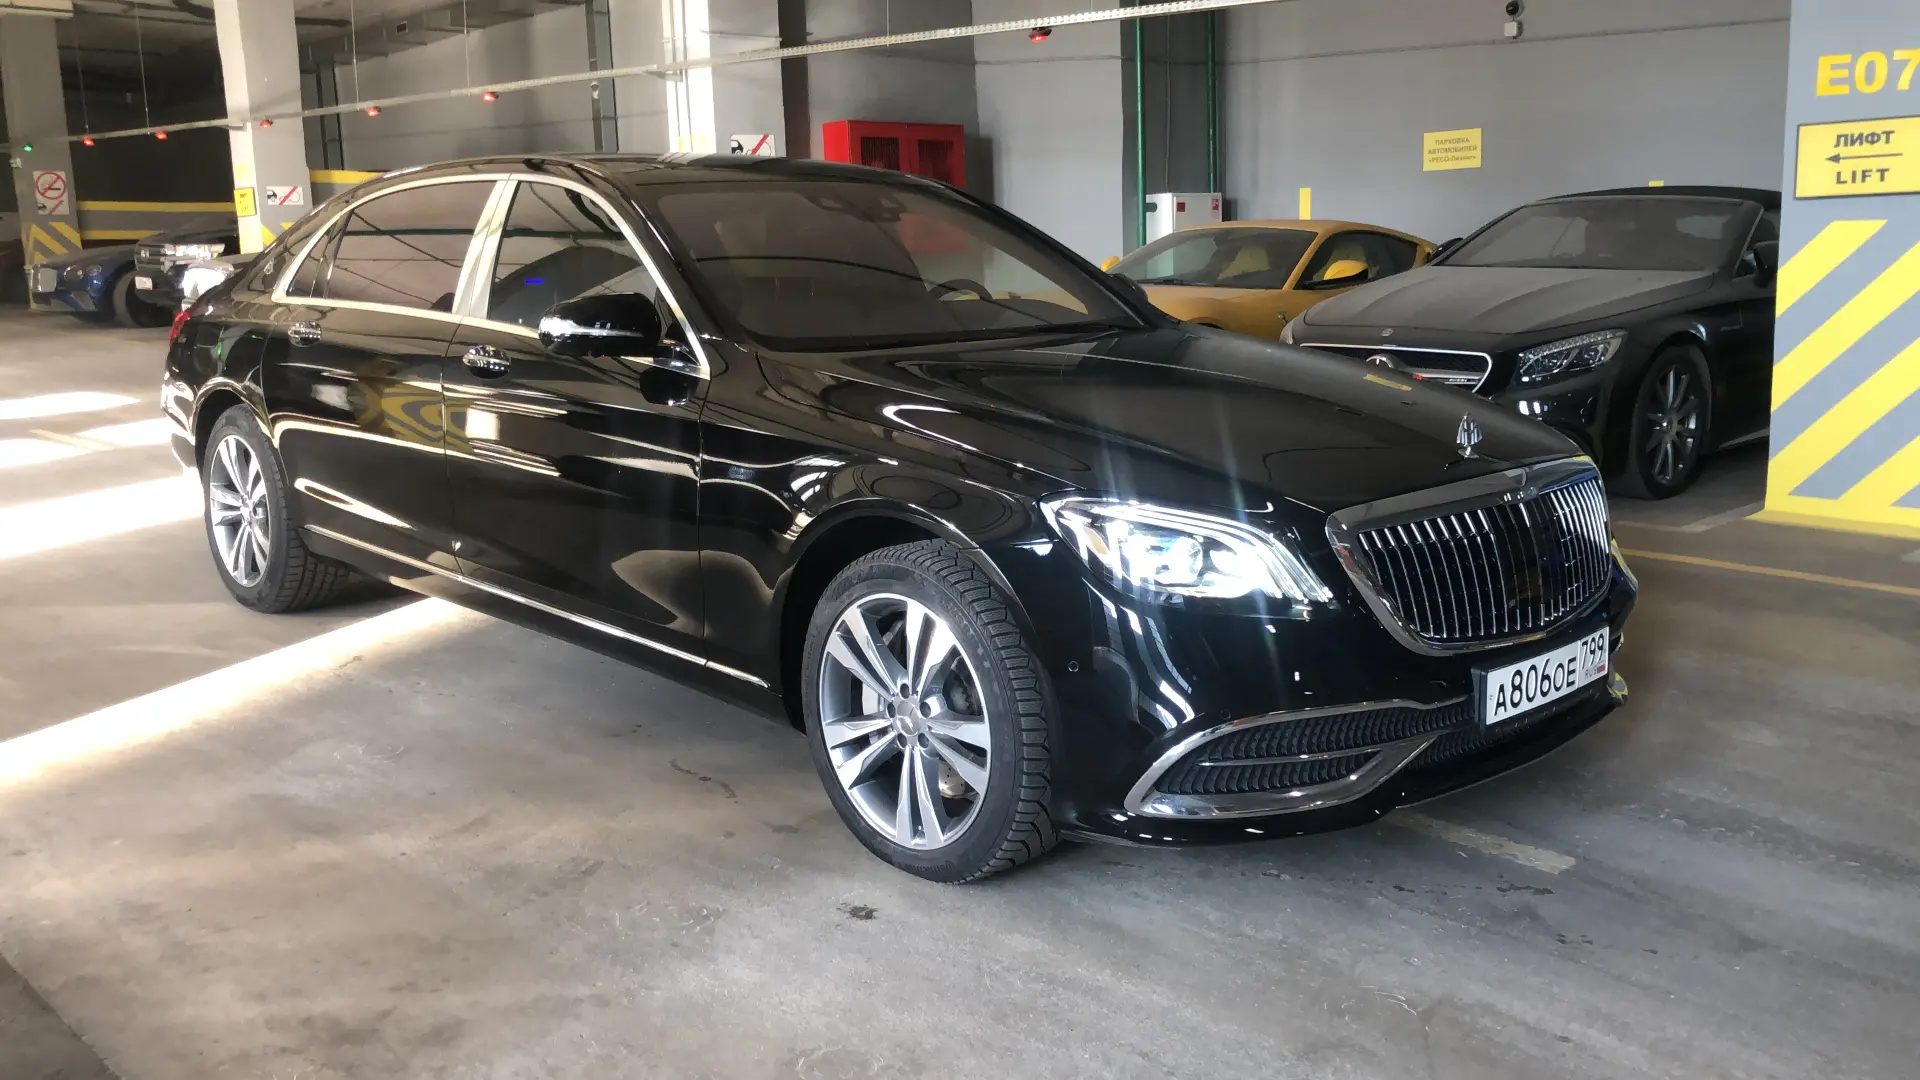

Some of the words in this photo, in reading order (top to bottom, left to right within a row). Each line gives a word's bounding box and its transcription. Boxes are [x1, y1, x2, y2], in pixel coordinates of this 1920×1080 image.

[1815, 48, 1920, 97] E07
[1834, 130, 1896, 148] ЛИФТ
[1836, 168, 1890, 184] LIFT
[1581, 632, 1604, 670] 799
